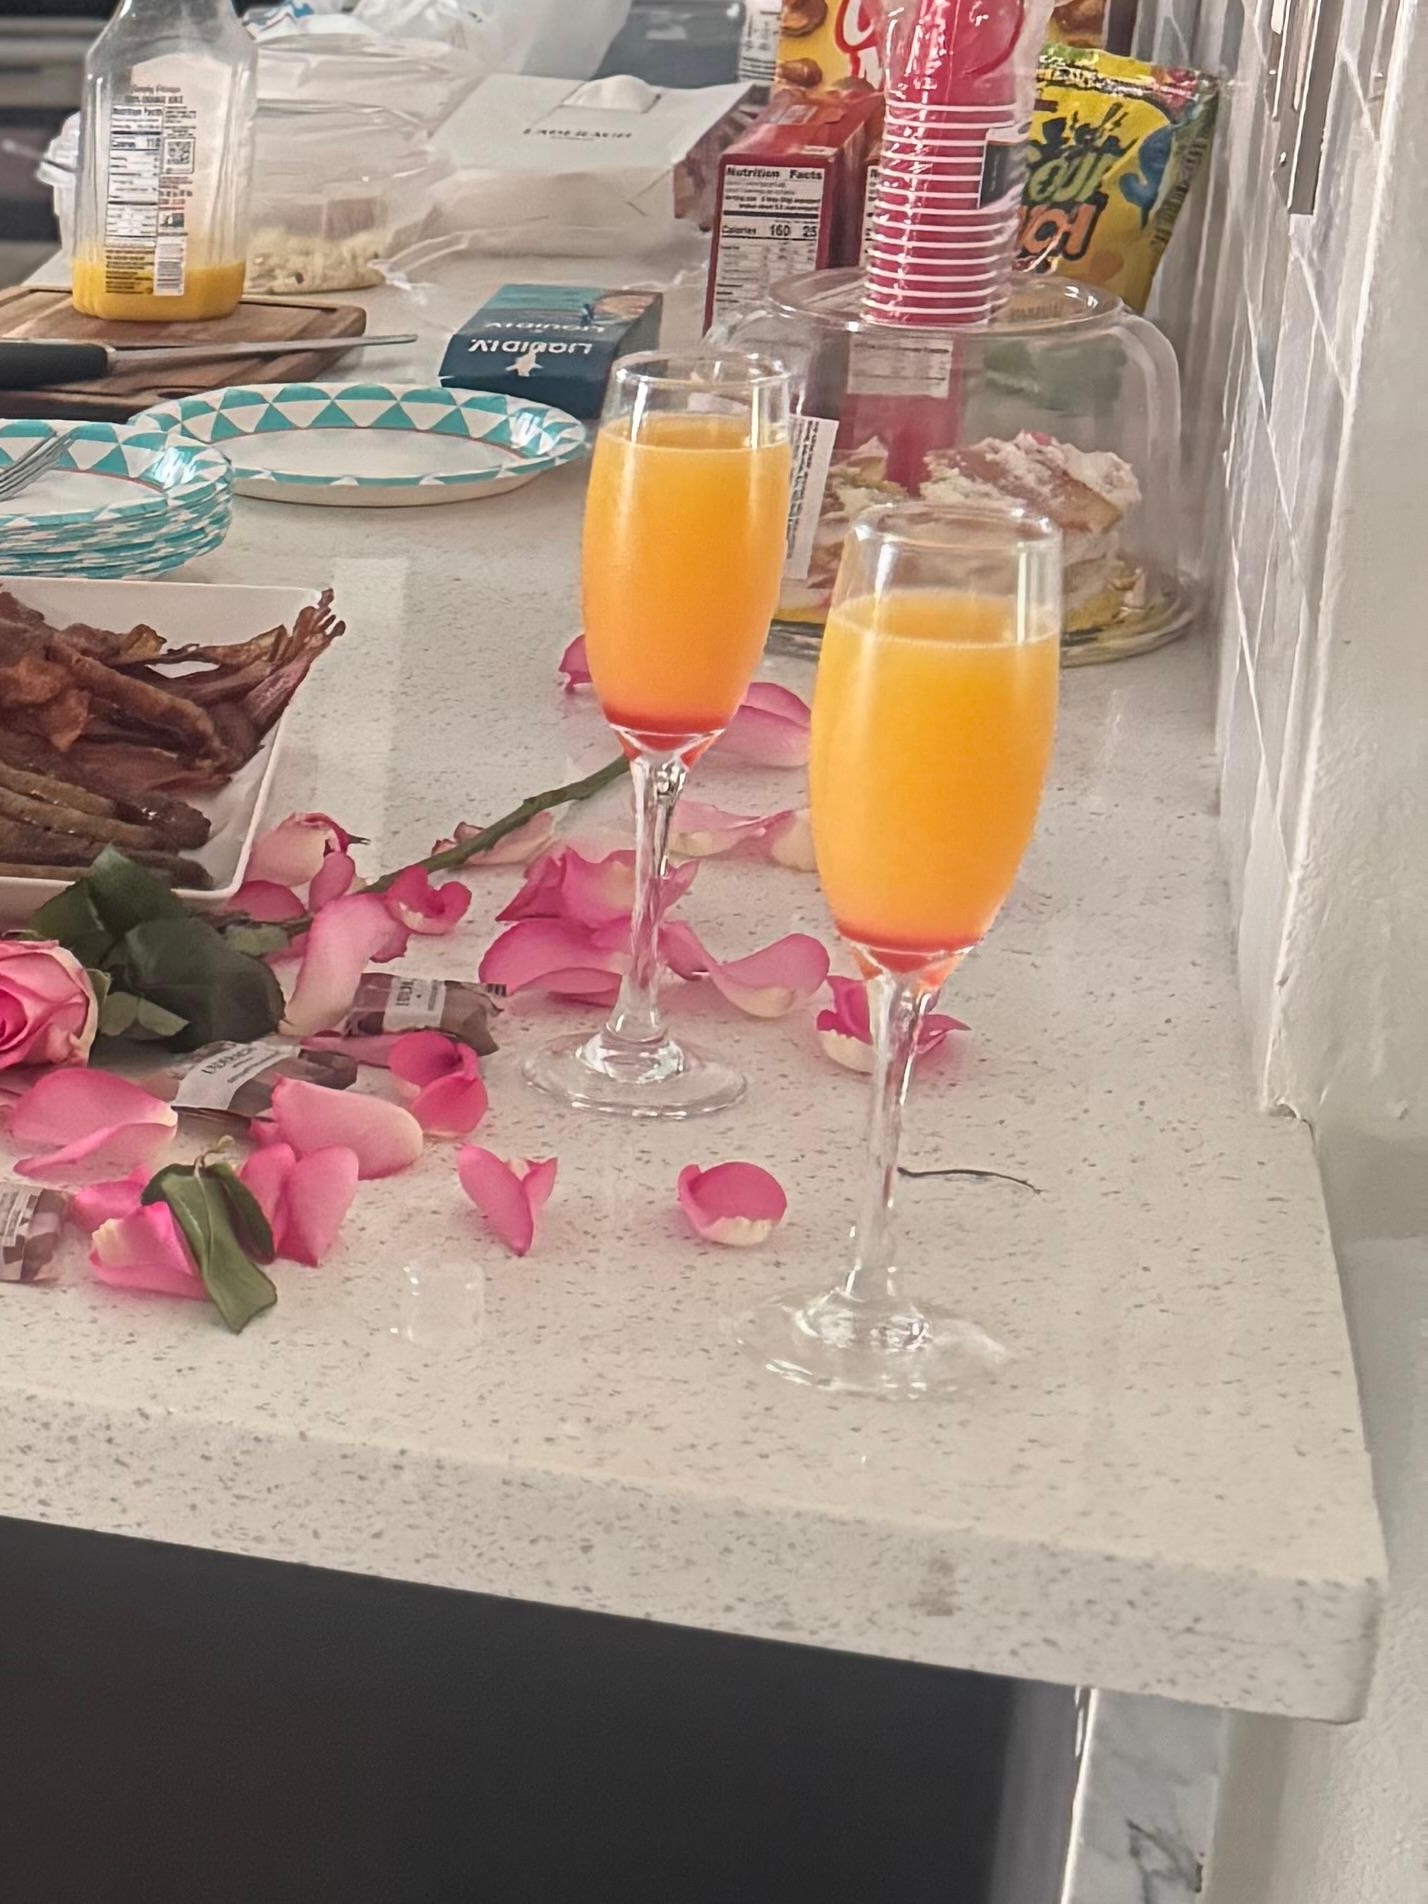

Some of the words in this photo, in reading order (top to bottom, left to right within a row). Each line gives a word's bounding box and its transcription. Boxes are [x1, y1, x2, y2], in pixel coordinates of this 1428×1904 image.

[726, 167, 781, 178] Nutrition
[789, 169, 823, 180] Facts
[721, 224, 757, 235] Calories
[769, 224, 791, 237] 160
[802, 225, 818, 238] 25
[502, 340, 593, 355] LIQUID
